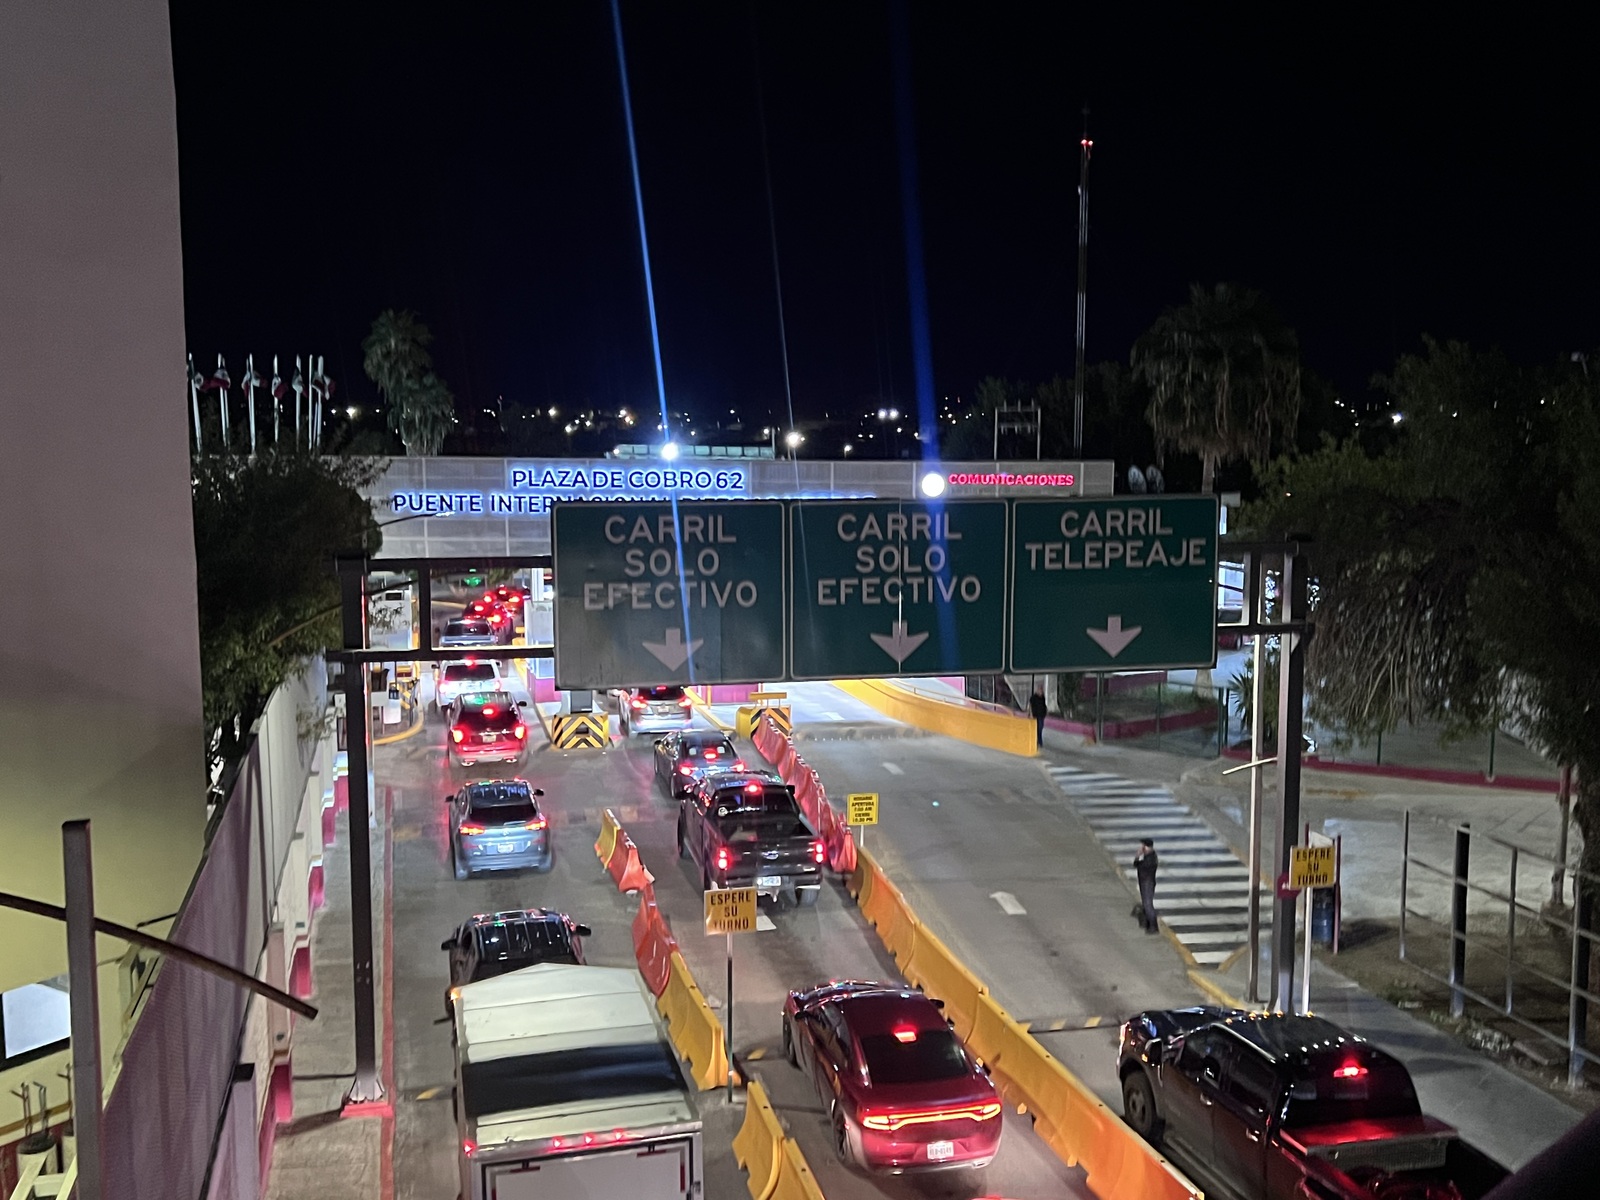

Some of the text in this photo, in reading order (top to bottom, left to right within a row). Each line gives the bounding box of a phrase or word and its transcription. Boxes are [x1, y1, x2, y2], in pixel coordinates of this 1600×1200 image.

[512, 470, 744, 489] PLAZA DE COBRO 62
[948, 473, 1074, 486] COMUNICACIONES
[393, 494, 482, 512] PUENTE
[604, 514, 737, 544] CARRIL
[837, 512, 962, 541] CARRIL
[1060, 507, 1173, 538] CARRIL
[624, 548, 720, 577] SOLO
[855, 545, 946, 574] SOLO
[1025, 538, 1206, 571] TELEPEAJE
[584, 580, 758, 610] EFECTIVO
[817, 575, 981, 605] EFECTIVO
[1298, 872, 1328, 886] TURNO
[1308, 861, 1319, 873] SU
[710, 890, 751, 905] ESPERE
[724, 905, 738, 918] SU
[713, 917, 749, 931] TURNO
